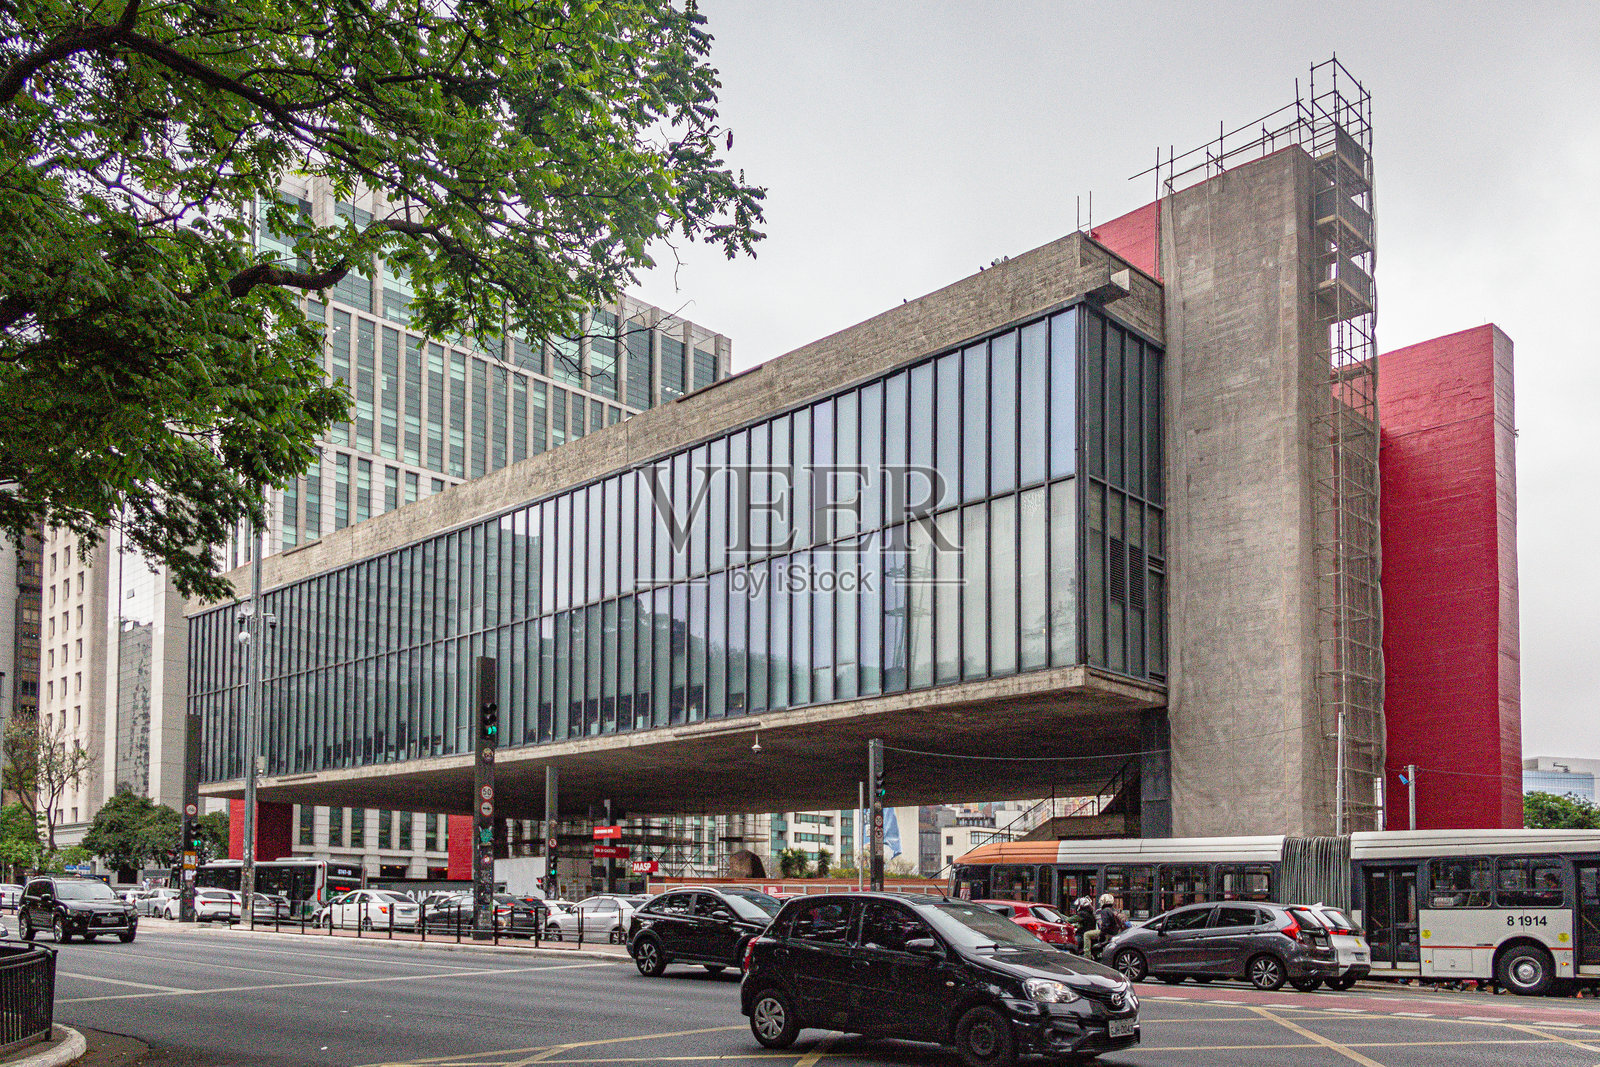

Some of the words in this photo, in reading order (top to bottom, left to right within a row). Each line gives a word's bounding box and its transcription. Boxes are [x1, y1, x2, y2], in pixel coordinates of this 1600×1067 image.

[482, 788, 492, 796] 50
[633, 862, 652, 872] MASP
[1507, 915, 1515, 926] 8
[1517, 915, 1548, 926] 1914
